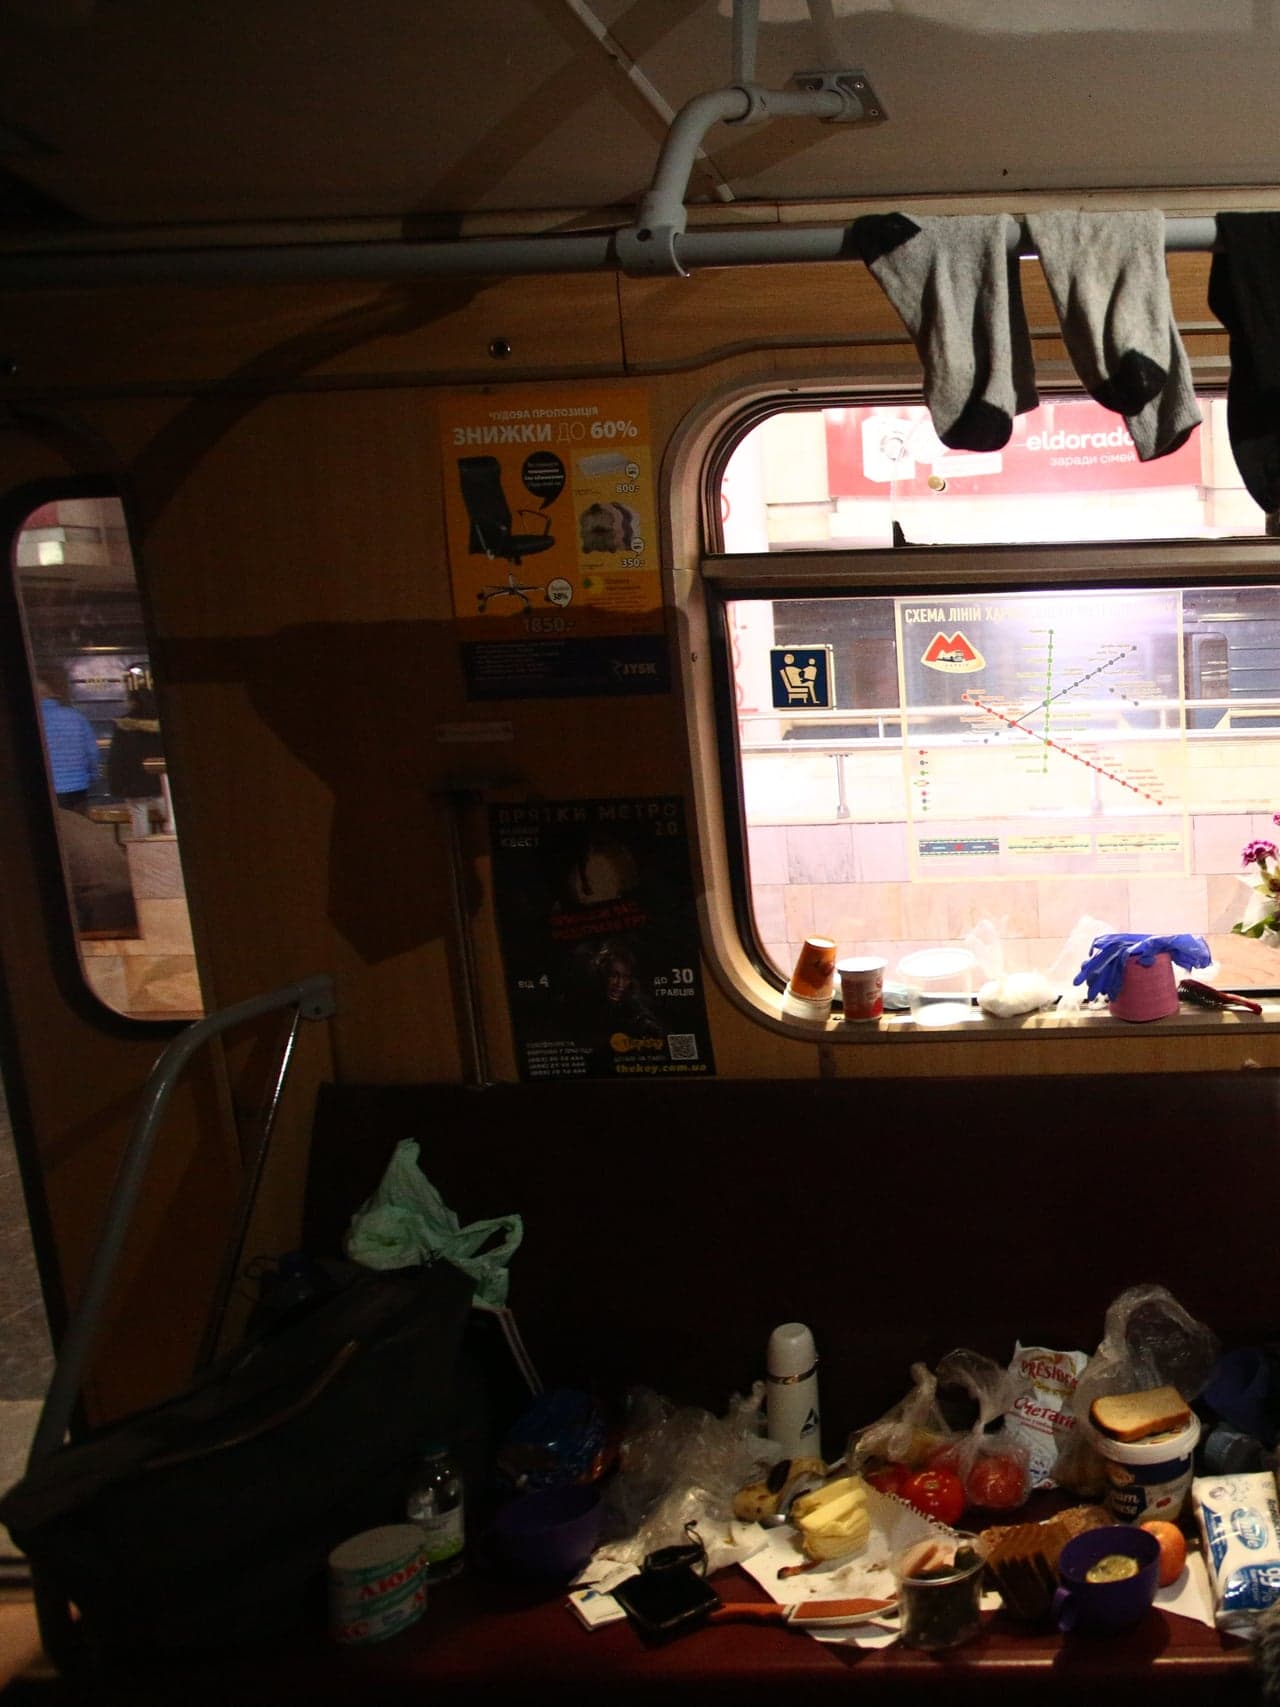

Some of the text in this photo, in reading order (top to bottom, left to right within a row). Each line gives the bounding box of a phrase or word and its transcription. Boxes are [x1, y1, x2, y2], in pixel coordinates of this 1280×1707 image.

[453, 420, 638, 446] ЗНИЖКИ ДО 60%
[1049, 451, 1136, 467] заради сімей
[905, 609, 946, 624] СХЕМА
[949, 608, 982, 622] ЛІНІЙ
[538, 973, 551, 988] 4
[671, 968, 694, 984] 30
